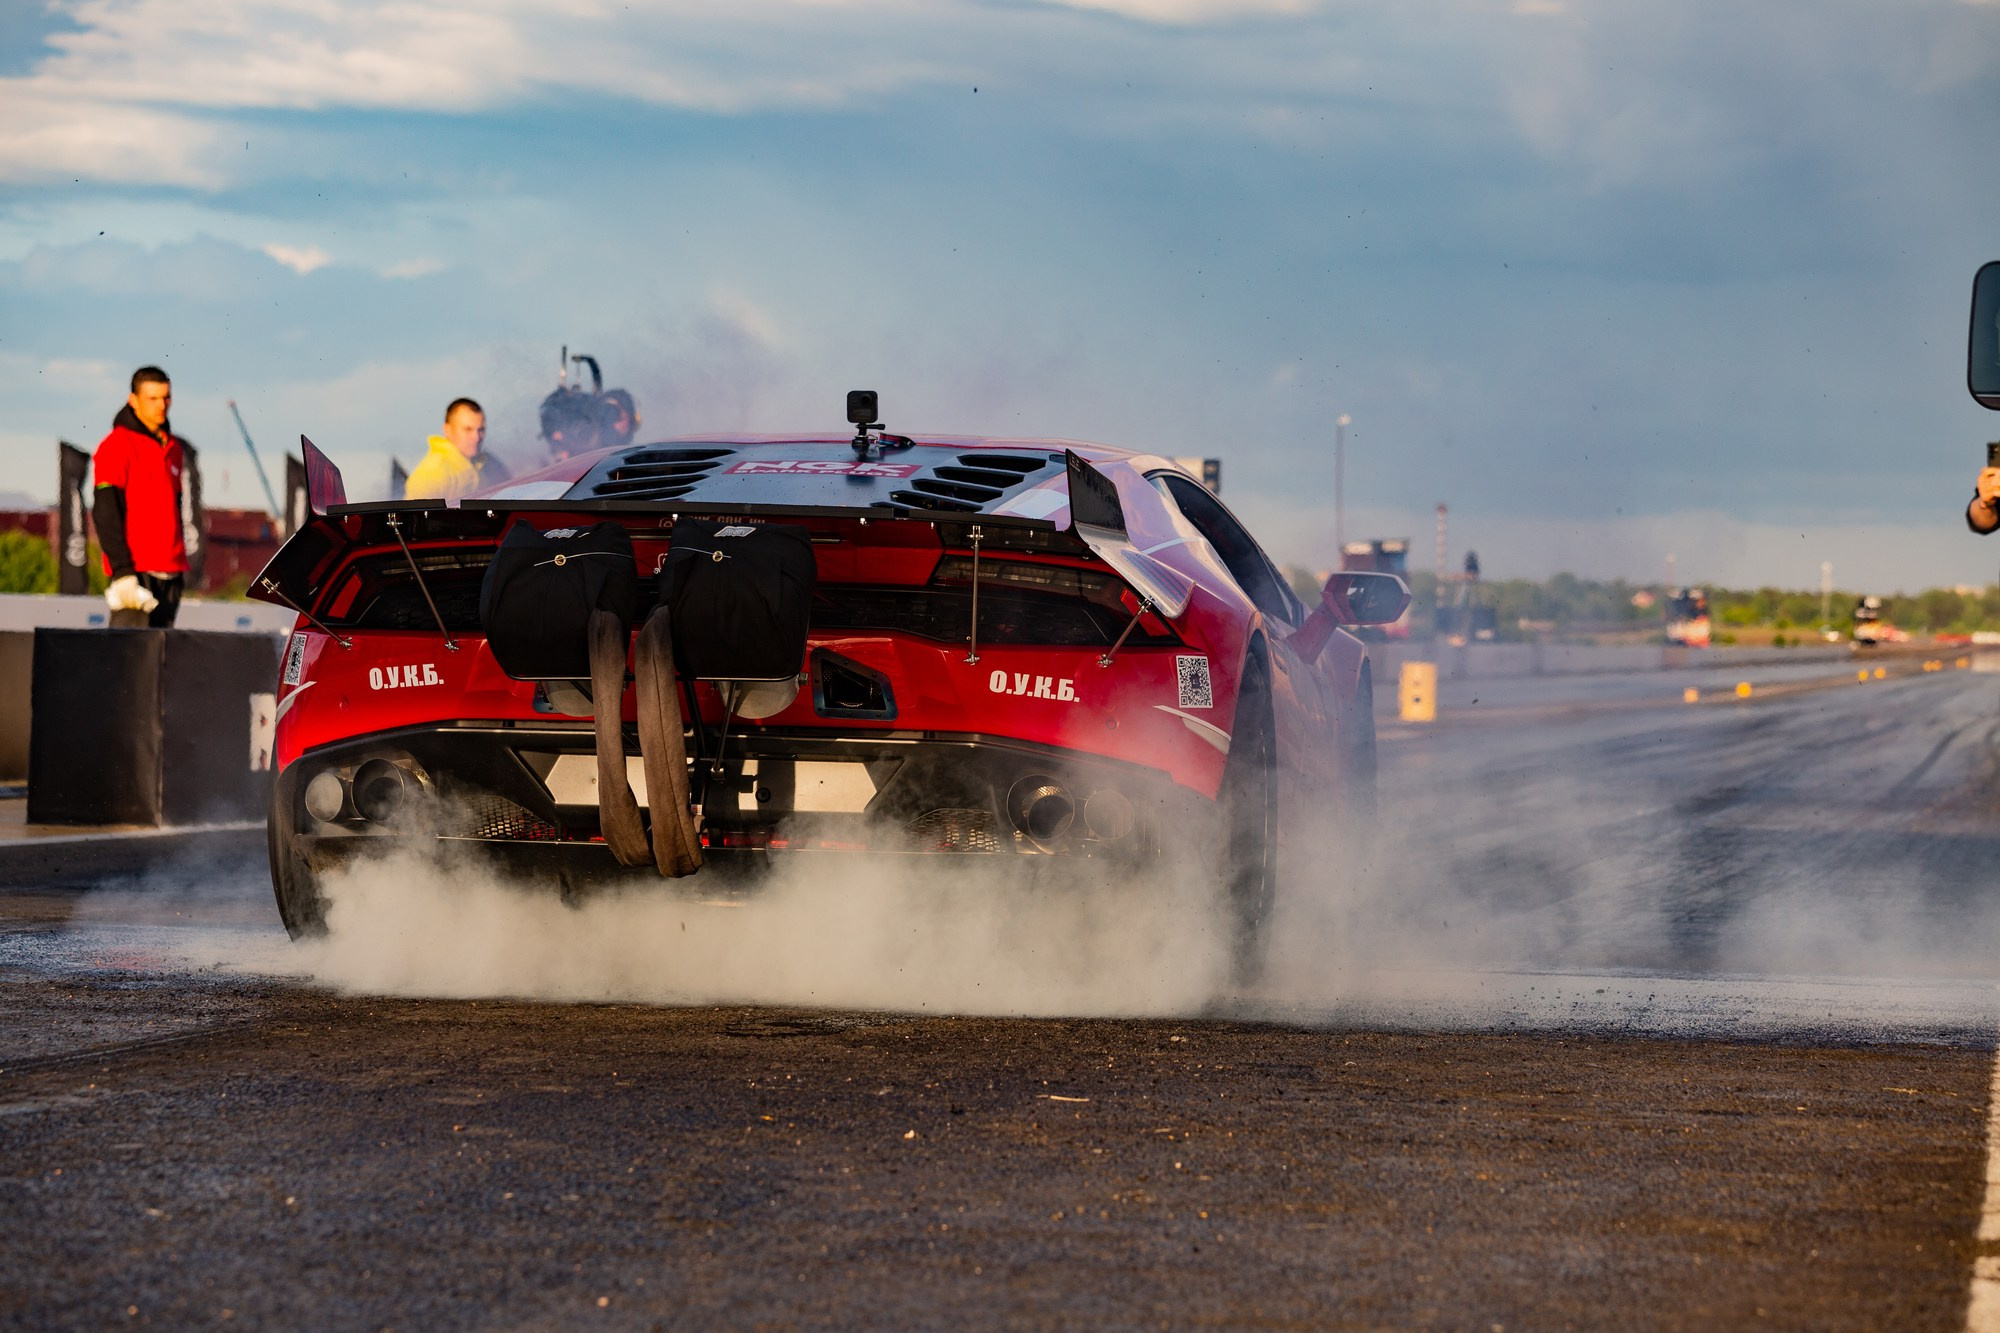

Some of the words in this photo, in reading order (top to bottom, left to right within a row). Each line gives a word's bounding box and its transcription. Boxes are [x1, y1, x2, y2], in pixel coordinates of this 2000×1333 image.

[739, 461, 911, 473] NGK
[369, 663, 444, 690] О.У.К.Б.
[989, 670, 1080, 702] О.У.К.Б.
